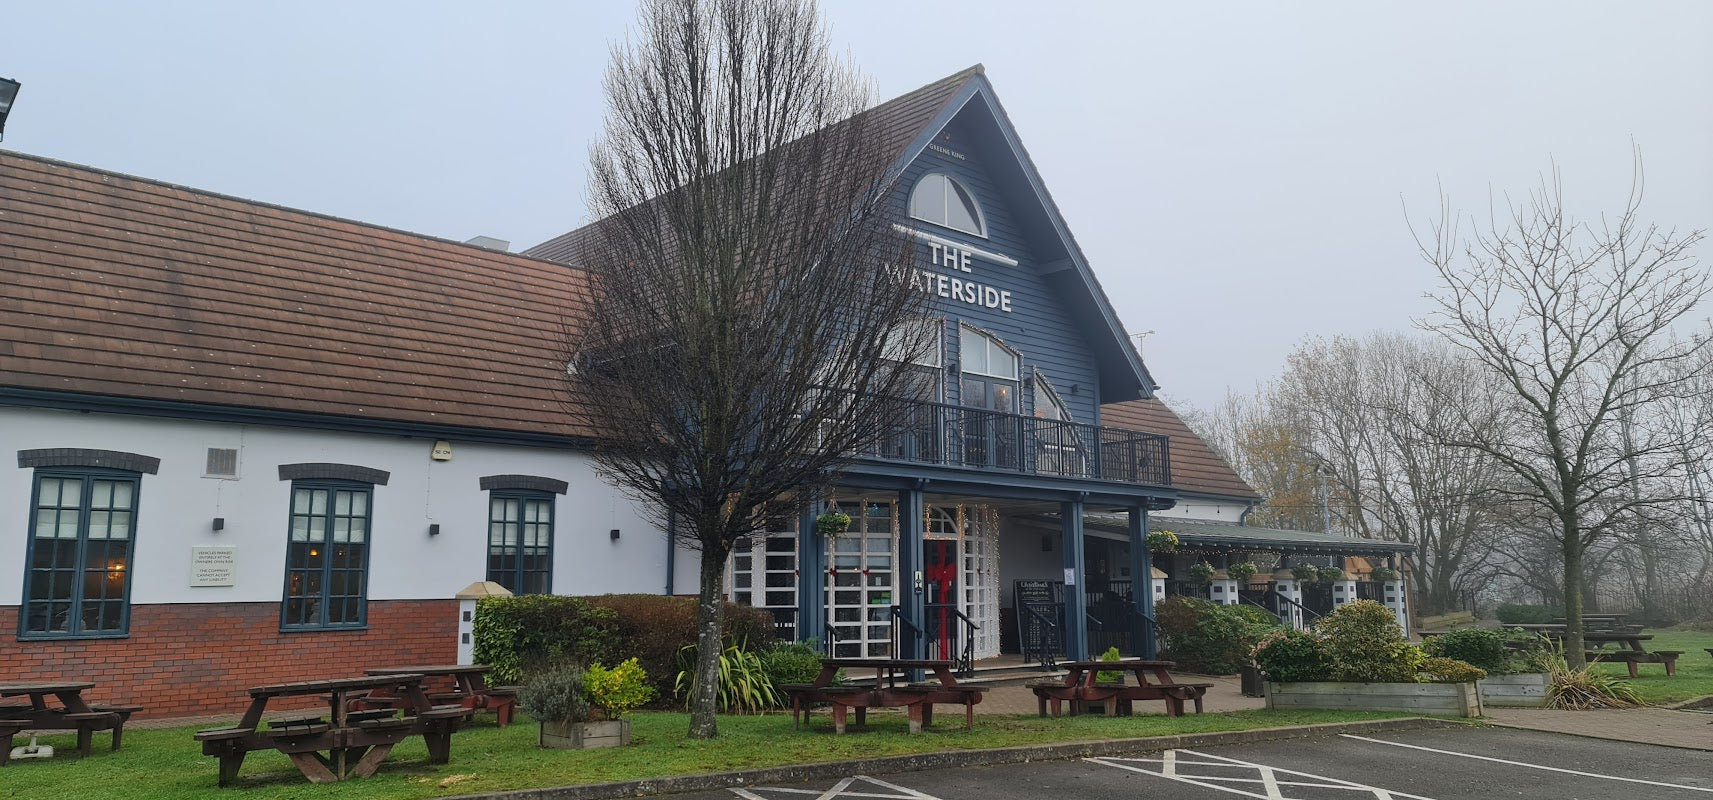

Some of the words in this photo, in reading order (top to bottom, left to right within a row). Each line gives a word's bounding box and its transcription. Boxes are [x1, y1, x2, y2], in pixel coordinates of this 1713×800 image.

[929, 143, 950, 156] GREENE
[951, 150, 965, 160] KING
[928, 242, 972, 273] THE
[885, 263, 1012, 312] WATERSIDE
